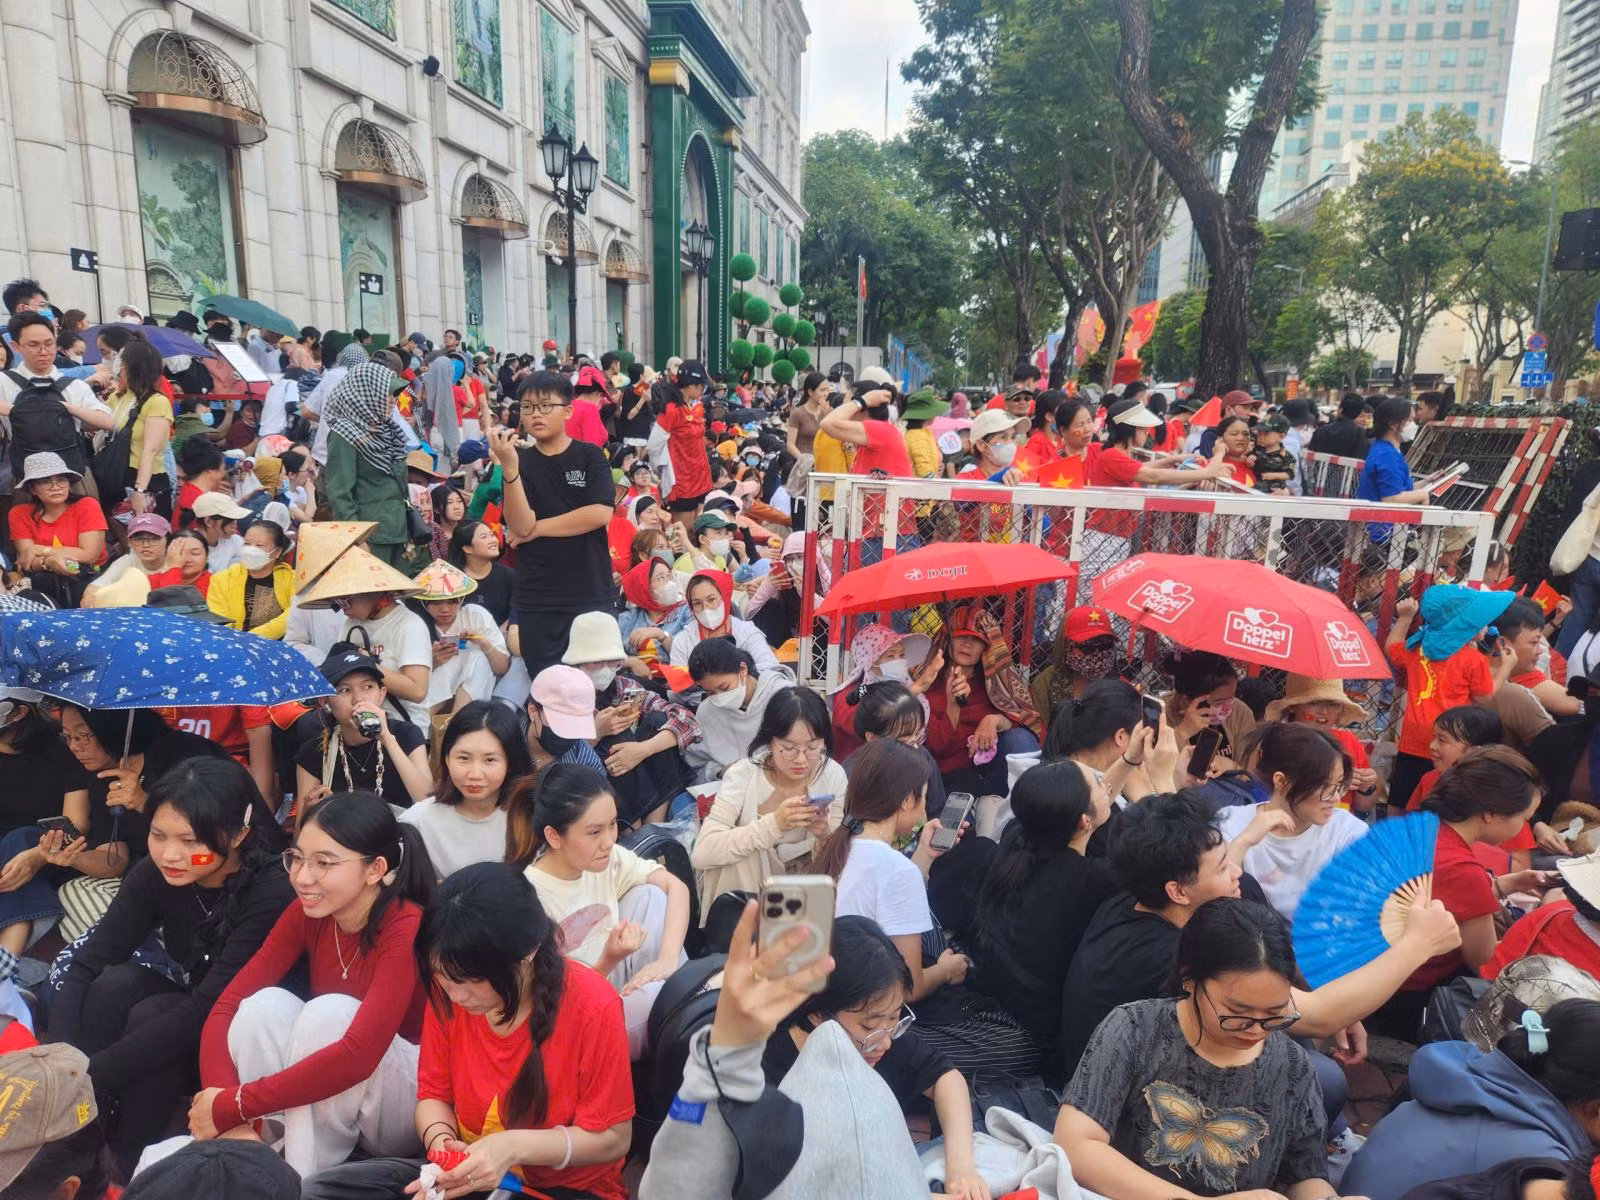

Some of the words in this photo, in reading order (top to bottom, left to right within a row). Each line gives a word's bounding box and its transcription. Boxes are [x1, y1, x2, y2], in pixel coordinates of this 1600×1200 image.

[927, 565, 967, 580] DOJI
[1142, 585, 1185, 609] Doppel
[1142, 597, 1168, 614] herz
[1232, 617, 1286, 641] Doppel
[1242, 632, 1274, 650] herz
